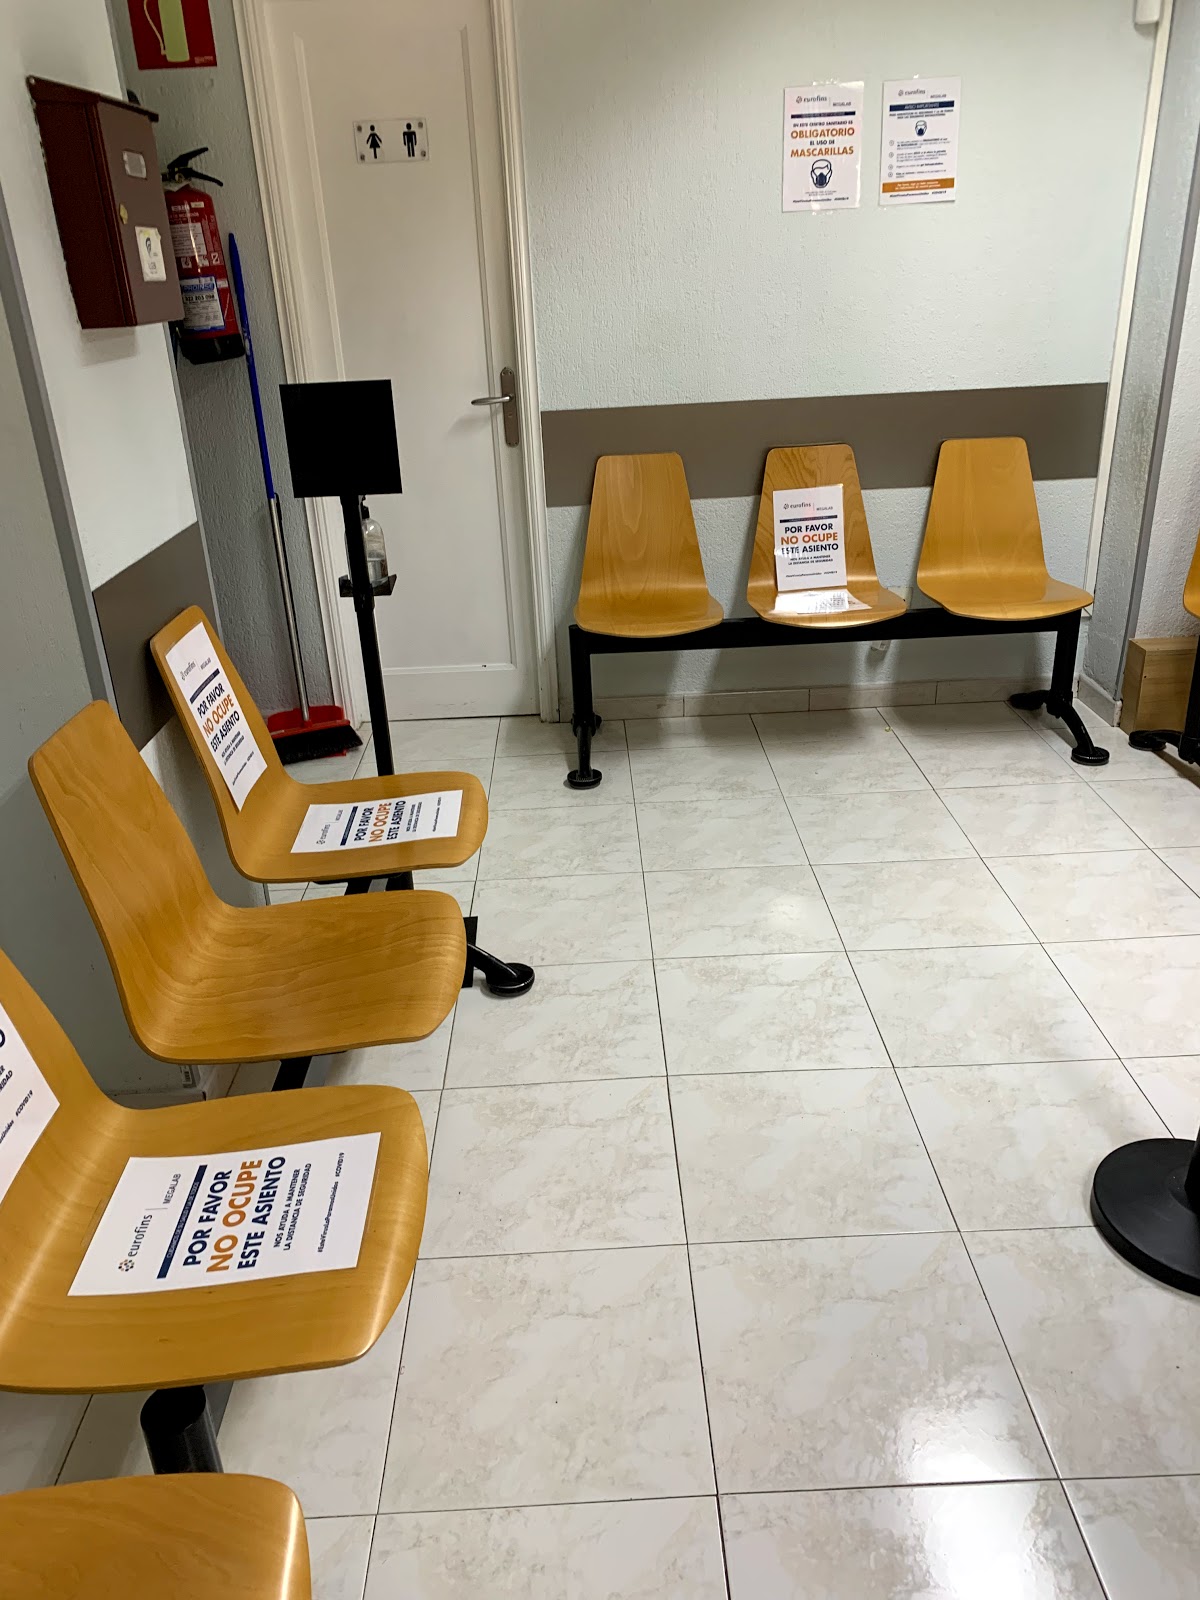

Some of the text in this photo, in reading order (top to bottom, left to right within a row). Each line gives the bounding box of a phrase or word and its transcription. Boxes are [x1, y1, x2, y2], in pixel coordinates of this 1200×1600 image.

[803, 94, 827, 103] eurofins
[790, 127, 855, 140] OBLIGATORIO
[790, 146, 854, 158] MASCARILLAS
[781, 532, 838, 546] NO OCUPE
[784, 523, 834, 534] POR FAVOR
[781, 543, 839, 555] ESTE ASIENTO
[196, 700, 208, 719] POR
[206, 682, 225, 708] FAVOR
[202, 720, 215, 738] NO
[213, 694, 235, 723] OCUPE
[210, 734, 223, 753] ESTE
[219, 710, 240, 741] ASIENTO
[354, 806, 375, 842] POR FAVOR
[369, 802, 392, 843] NO OCUPE
[386, 800, 407, 841] ESTE ASIENTO
[15, 1089, 33, 1117] #COVID19
[335, 1151, 346, 1178] #COVID19
[127, 1172, 182, 1258] eurofins MEGALAB
[182, 1169, 233, 1267] POR FAVOR
[205, 1159, 263, 1273] NO OCUPE
[237, 1156, 286, 1270] ESTE ASIENTO
[273, 1231, 283, 1249] NOS
[278, 1207, 290, 1232] AYUDA
[286, 1167, 301, 1203] MANTENER
[283, 1162, 313, 1252] LA DISTANCIA DE SEGURIDAD
